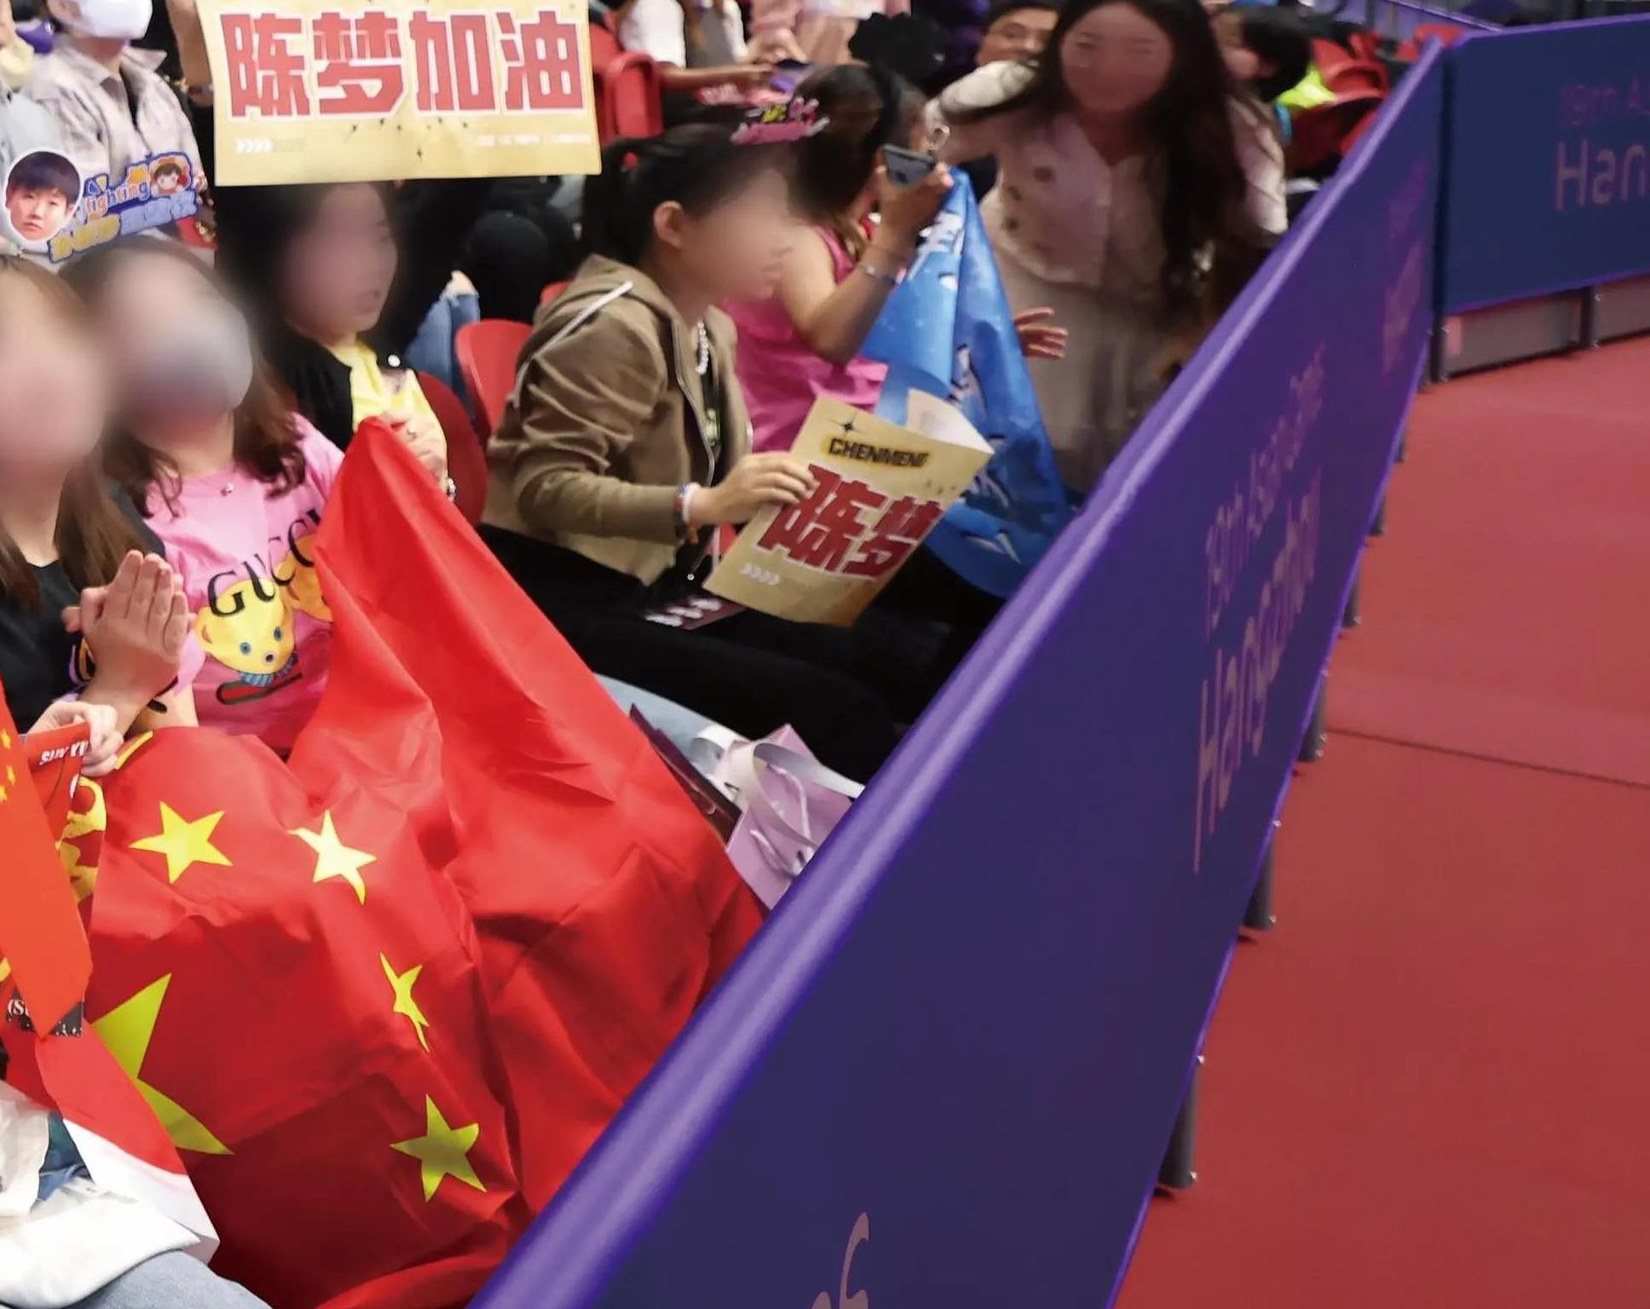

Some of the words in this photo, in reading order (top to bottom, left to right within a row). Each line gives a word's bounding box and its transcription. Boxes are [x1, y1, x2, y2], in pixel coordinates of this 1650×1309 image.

[218, 9, 587, 119] 陈梦加油
[757, 463, 944, 580] 陈梦
